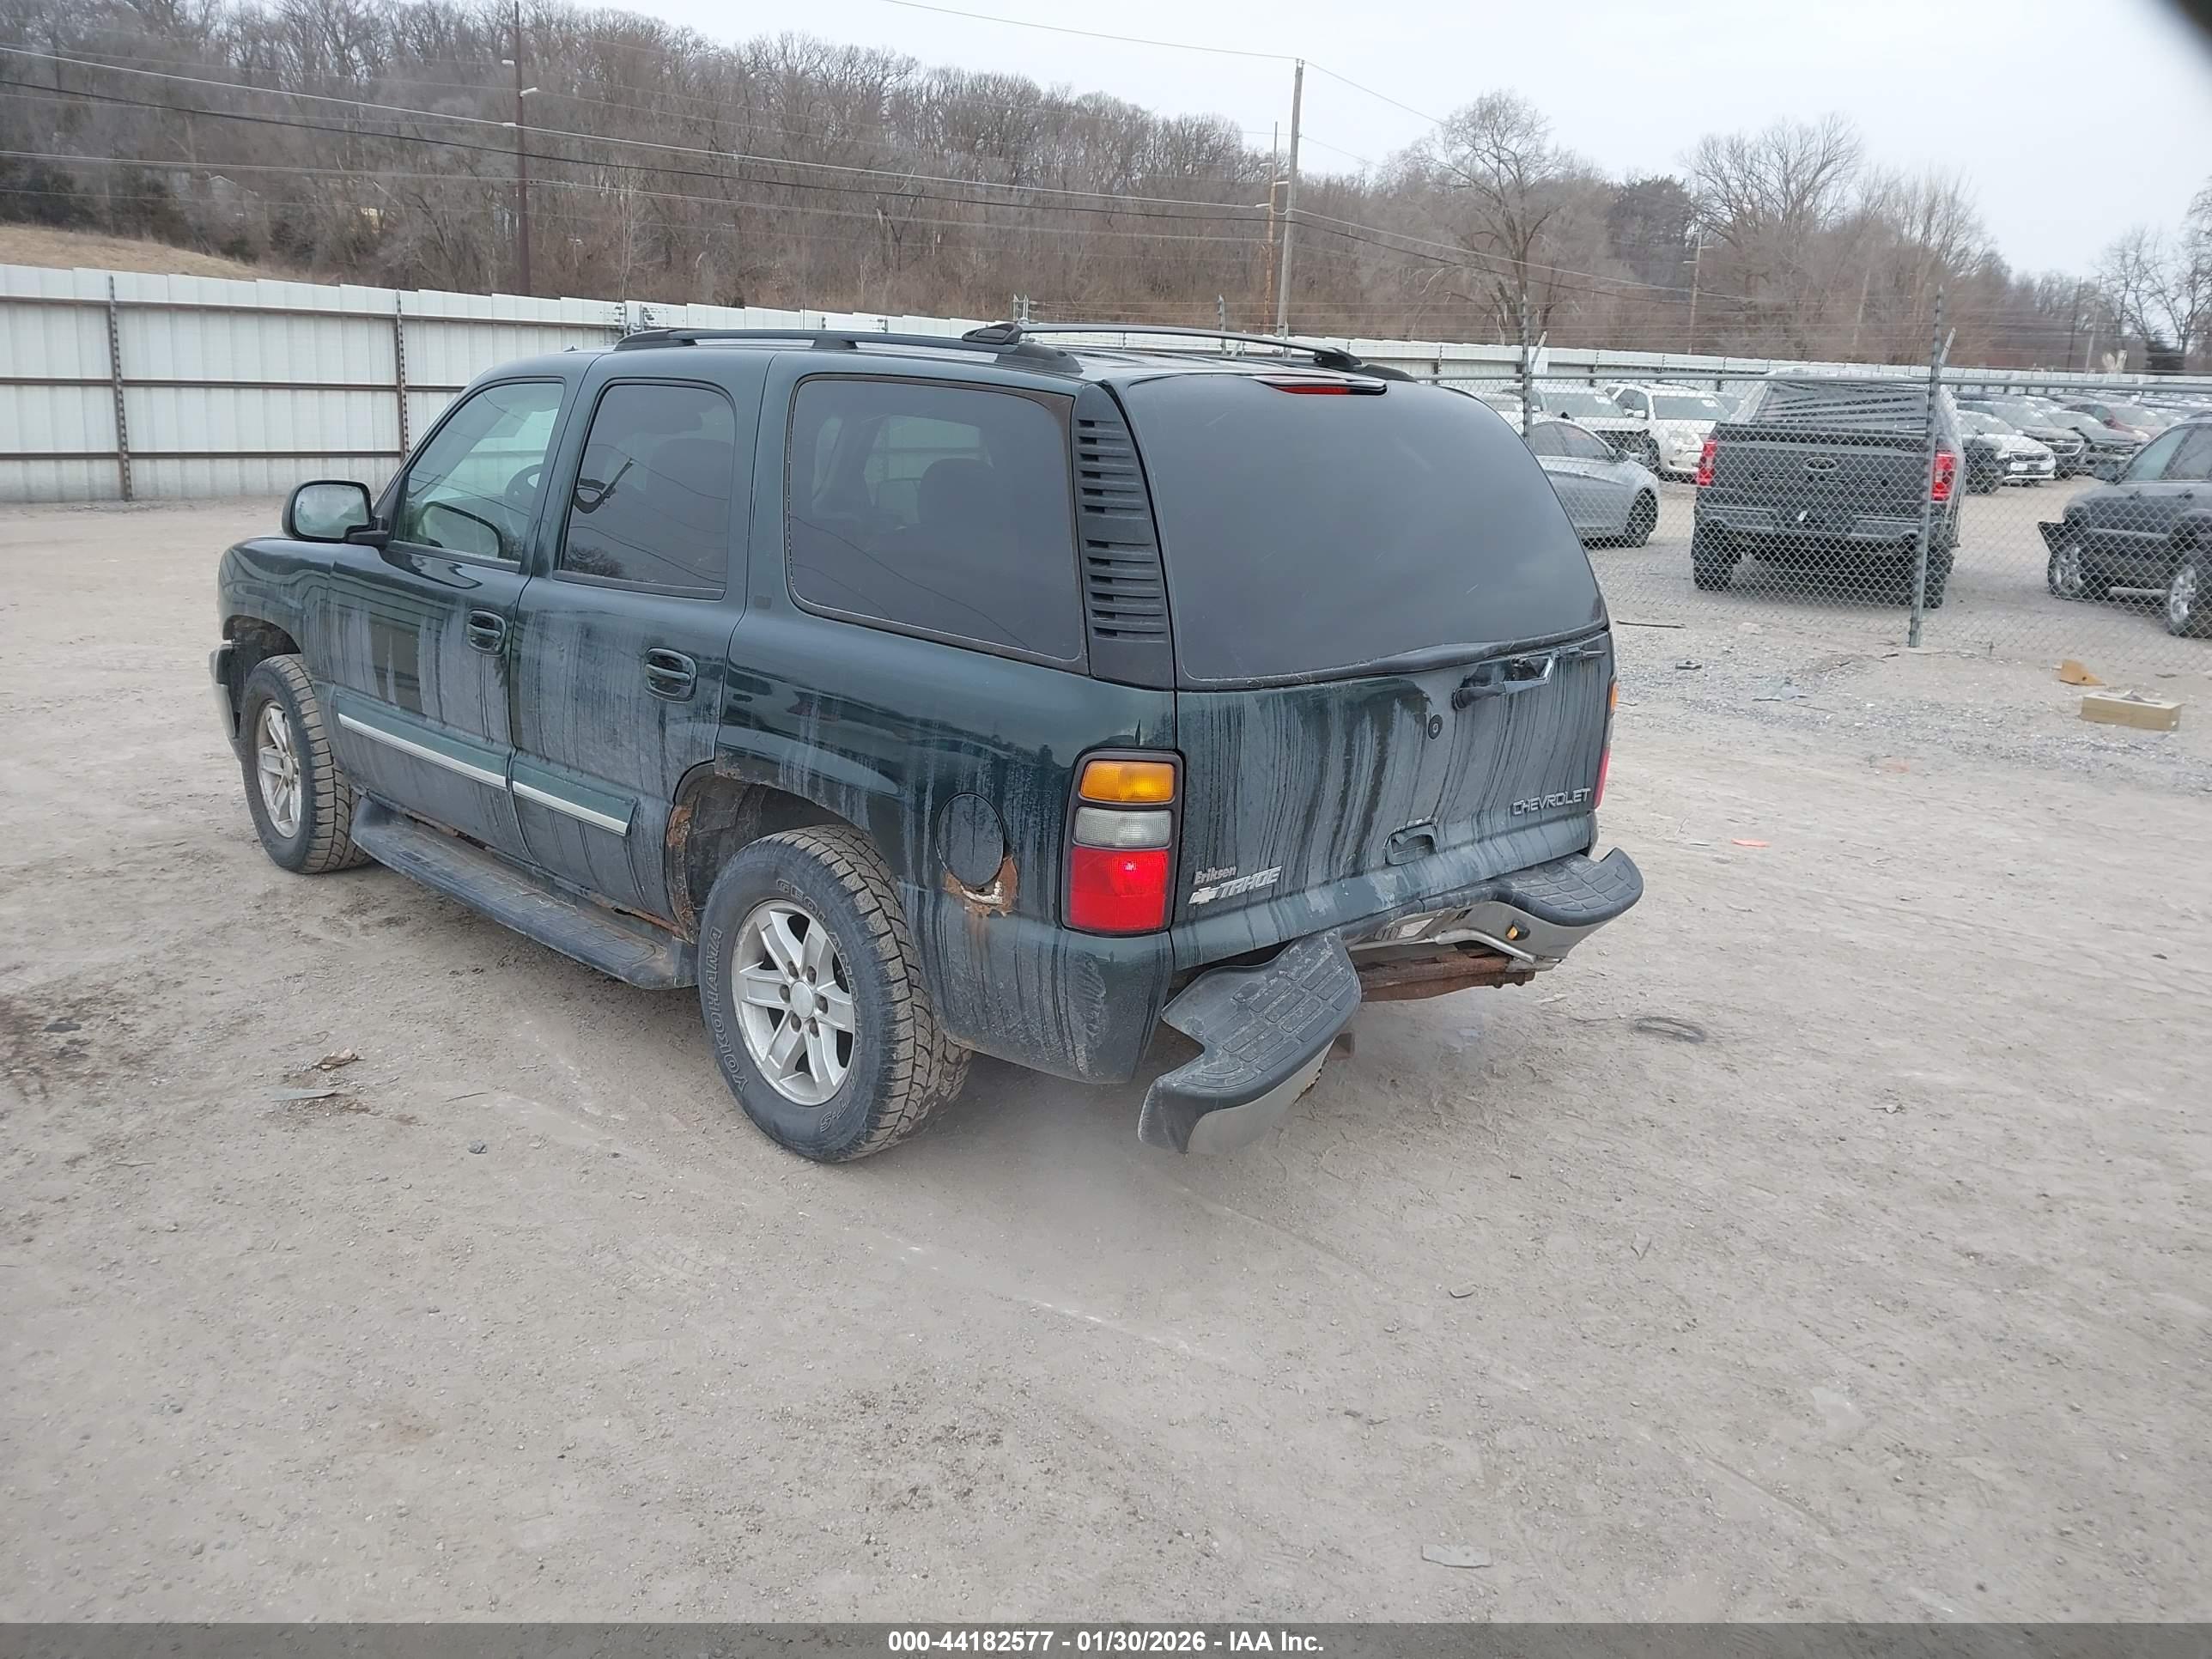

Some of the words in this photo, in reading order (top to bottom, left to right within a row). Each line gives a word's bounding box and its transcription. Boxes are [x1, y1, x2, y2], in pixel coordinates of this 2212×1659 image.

[1512, 787, 1591, 815] CHEVROLET
[1194, 866, 1237, 886] Eriksen
[1218, 866, 1282, 899] TAHOE
[706, 927, 749, 1092] YOKOHAMA
